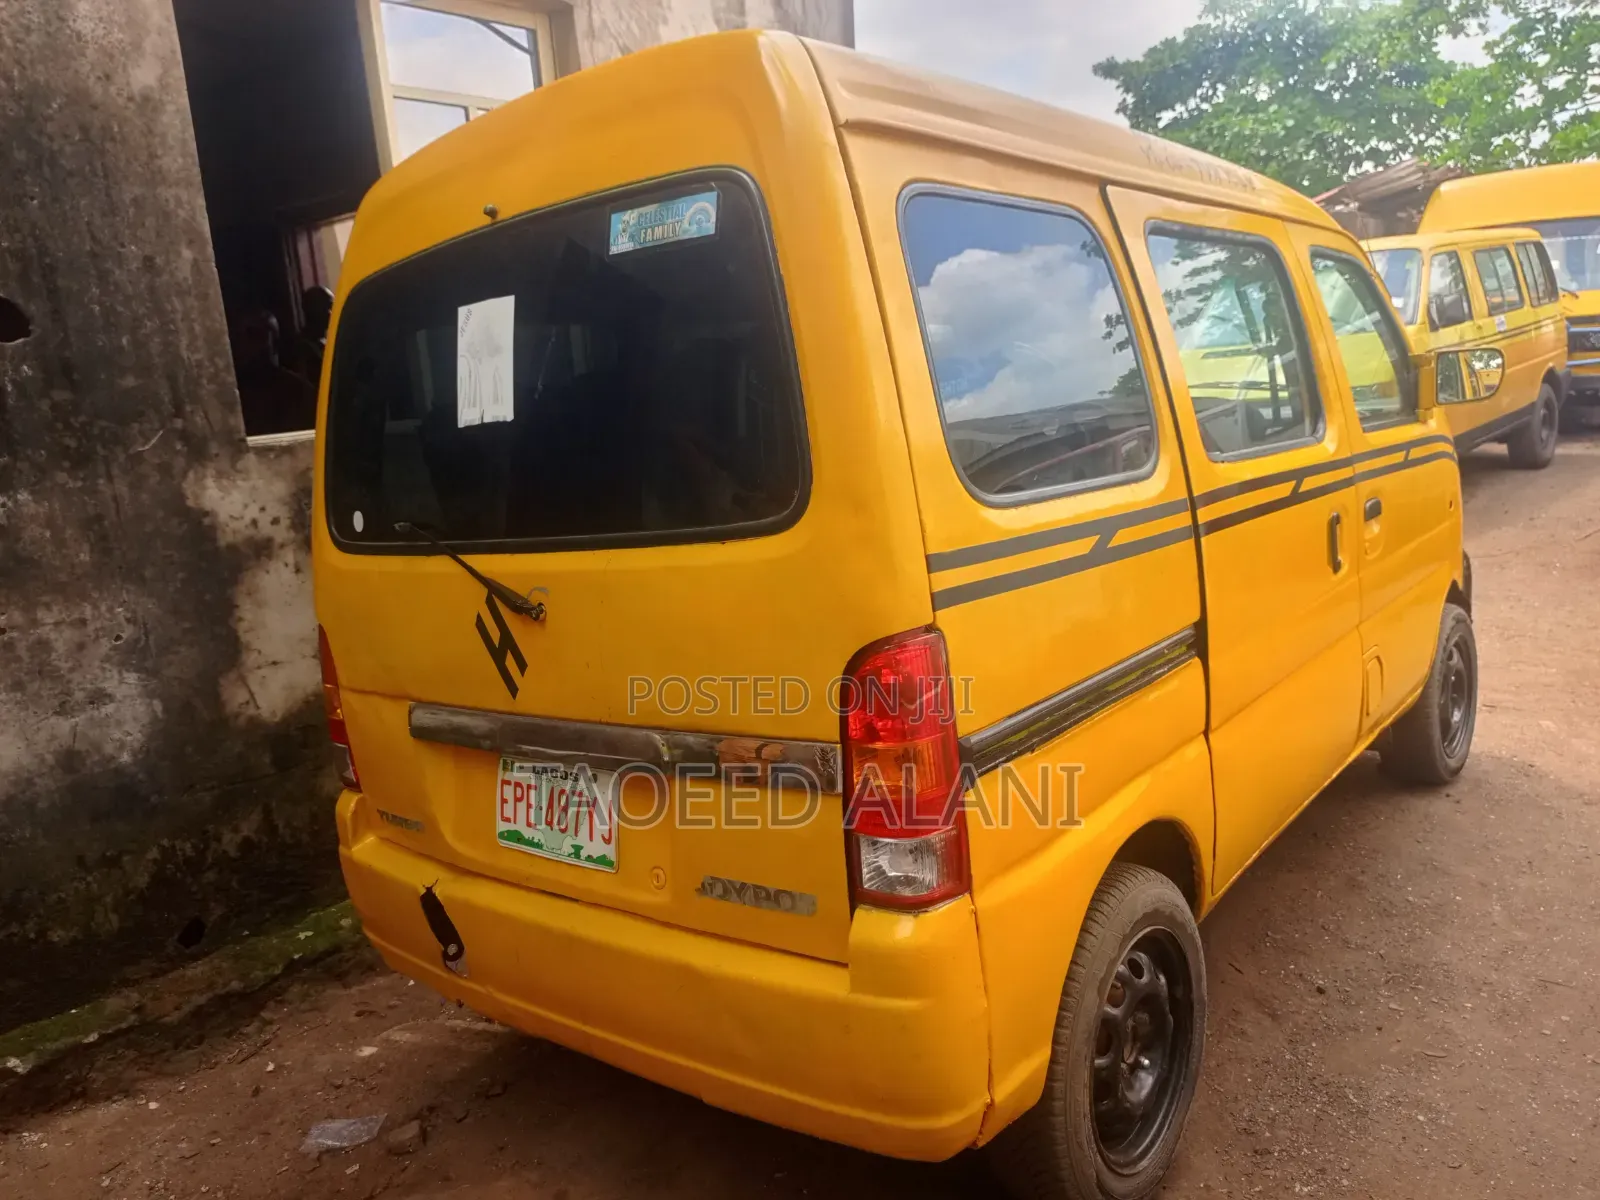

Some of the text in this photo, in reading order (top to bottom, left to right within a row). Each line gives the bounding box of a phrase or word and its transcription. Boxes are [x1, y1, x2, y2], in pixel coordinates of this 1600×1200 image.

[638, 203, 686, 227] CELESTIAL
[639, 221, 682, 244] FAMILY
[532, 765, 580, 783] LAGOS
